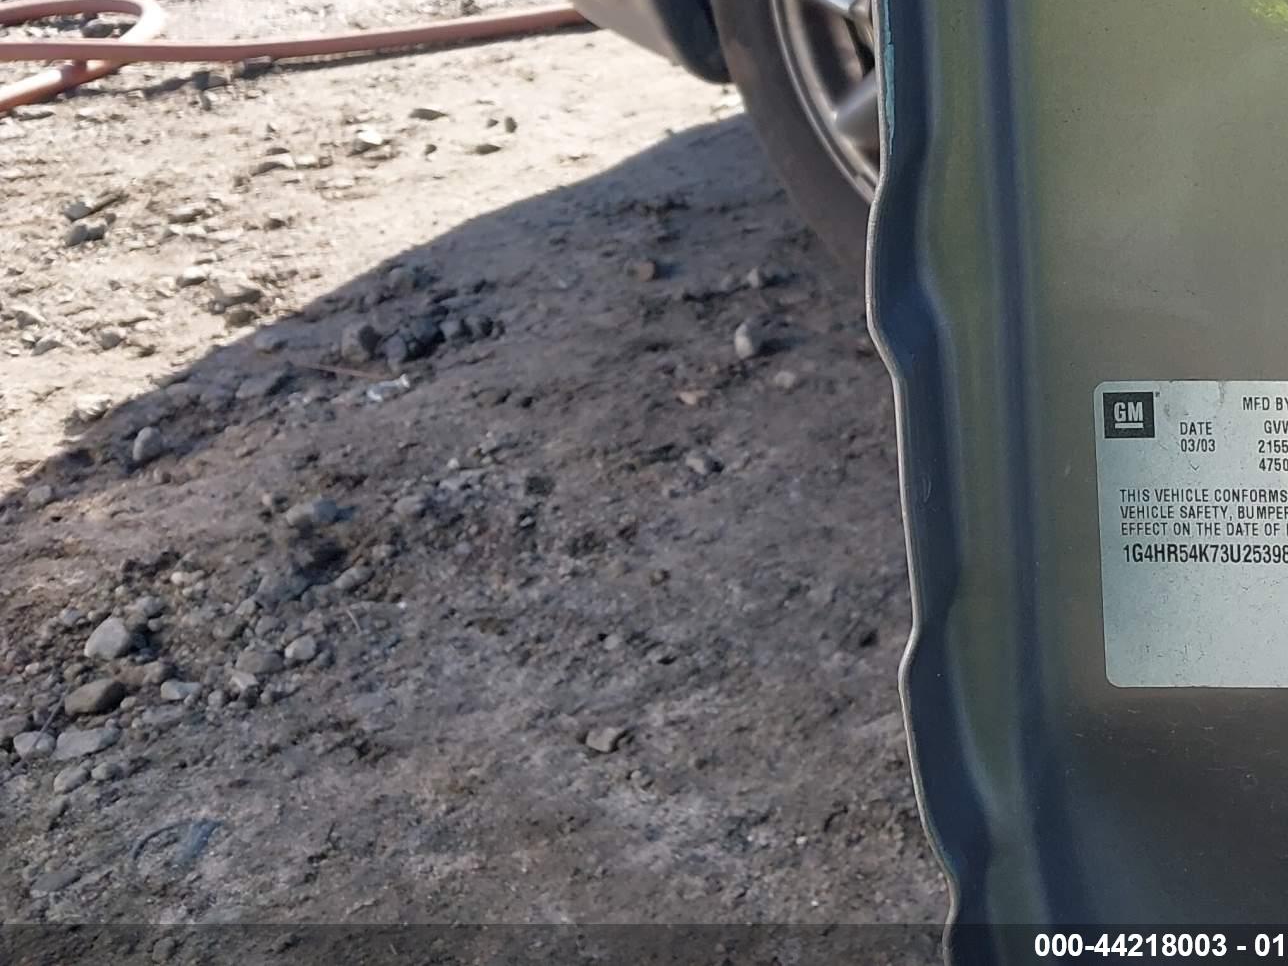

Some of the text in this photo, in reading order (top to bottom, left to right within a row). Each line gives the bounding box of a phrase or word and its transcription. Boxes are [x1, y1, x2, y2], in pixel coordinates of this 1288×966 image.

[1243, 397, 1270, 410] MFD
[1114, 401, 1144, 422] GM
[1180, 422, 1212, 435] DATE
[1181, 438, 1215, 452] 03/03
[1258, 440, 1288, 453] 2155
[1259, 458, 1288, 471] 4750
[1120, 489, 1149, 502] THIS
[1155, 489, 1211, 502] VEHICLE
[1215, 489, 1288, 503] CONFORMS
[1120, 505, 1174, 519] VEHICLE
[1180, 505, 1233, 521] SAFETY,
[1122, 522, 1168, 536] EFFECT
[1174, 522, 1190, 535] ON
[1196, 522, 1221, 536] THE
[1226, 522, 1258, 536] DATE
[1264, 523, 1280, 536] OF
